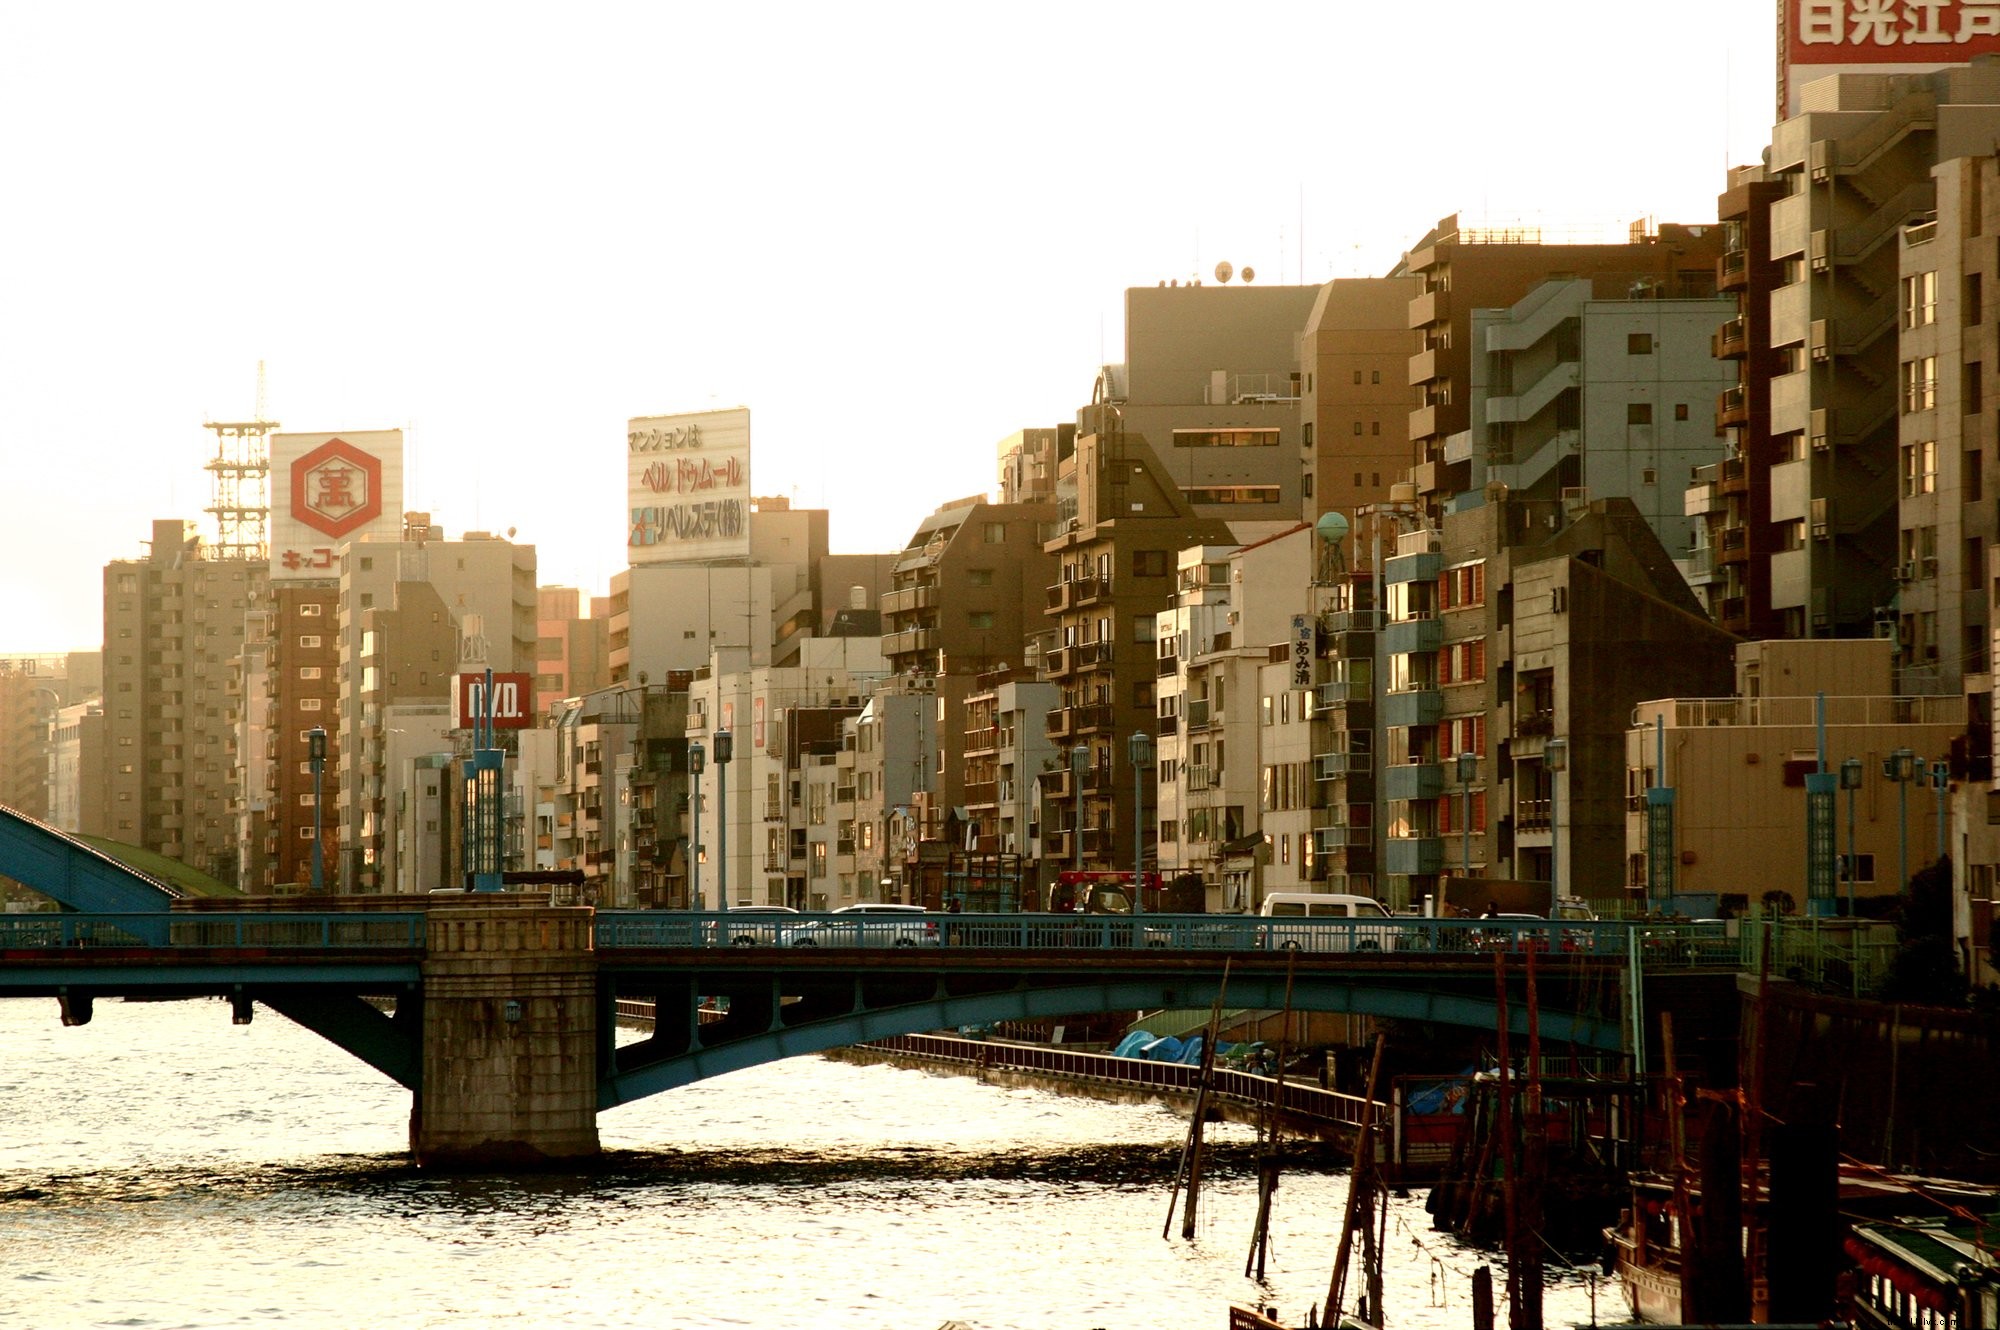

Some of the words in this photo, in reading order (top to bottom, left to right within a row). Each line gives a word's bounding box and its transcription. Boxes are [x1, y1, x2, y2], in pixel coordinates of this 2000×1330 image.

[628, 424, 702, 452] マンションは
[468, 682, 523, 718] B.V.D.
